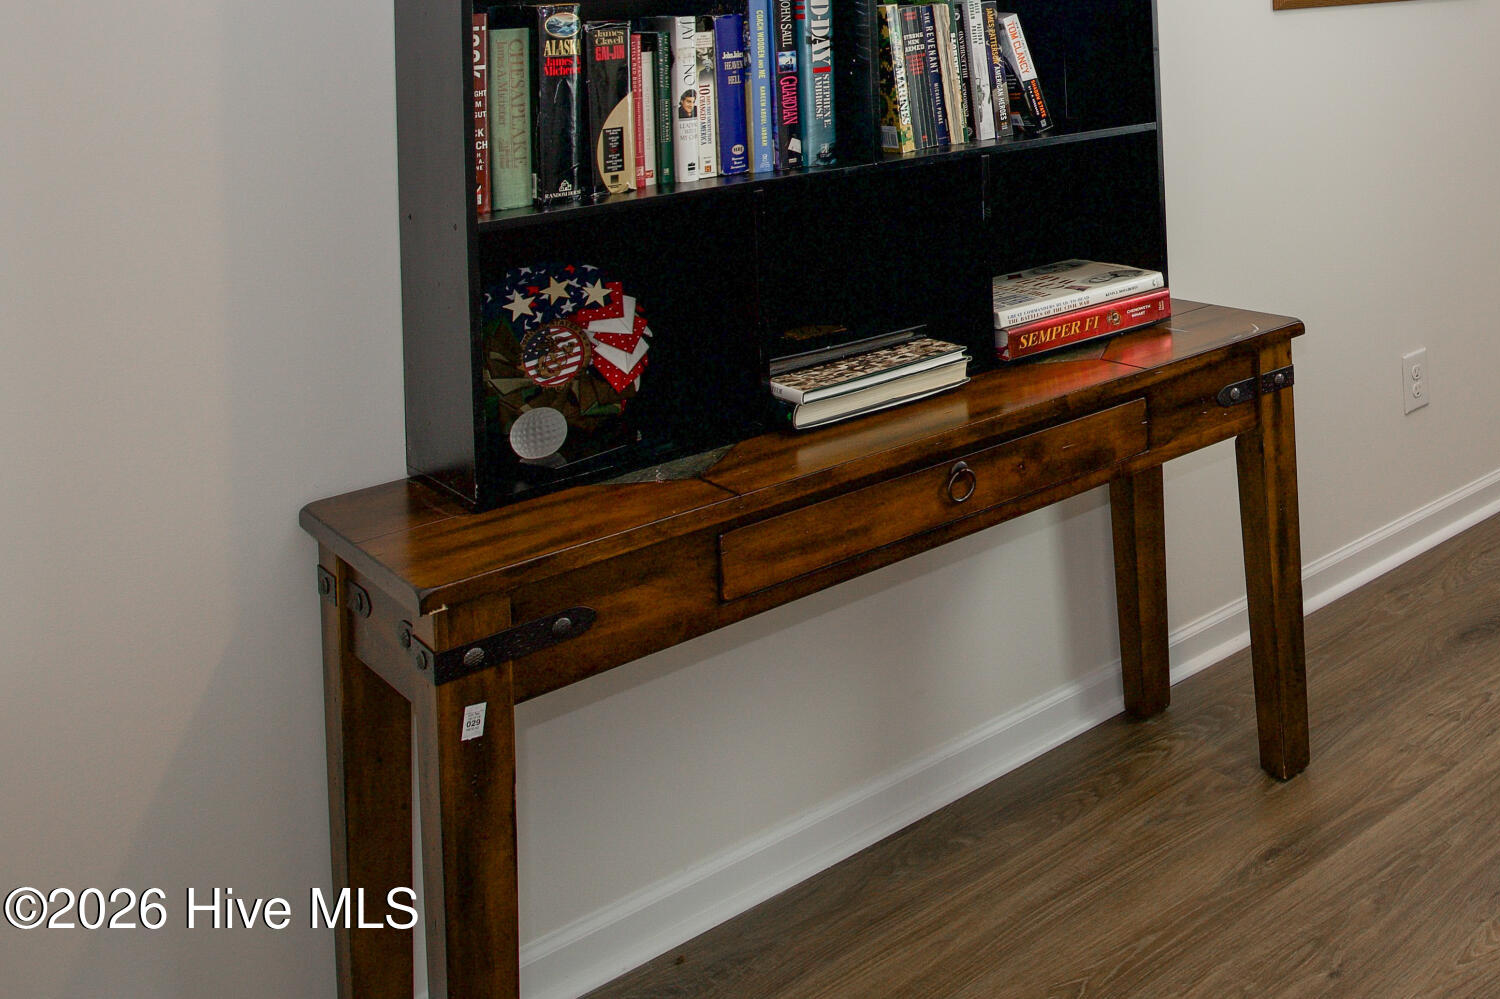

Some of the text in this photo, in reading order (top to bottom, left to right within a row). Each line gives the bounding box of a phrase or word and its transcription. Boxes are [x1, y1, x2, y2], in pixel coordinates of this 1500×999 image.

[680, 17, 695, 41] JAY
[755, 9, 764, 31] COACH
[594, 29, 624, 38] James
[595, 36, 624, 46] Clavell
[757, 31, 766, 58] WOODEN
[780, 23, 793, 48] SAUL
[544, 39, 581, 57] ALASKA
[594, 44, 625, 62] GAI-JIN
[905, 44, 925, 53] ARMED
[925, 25, 939, 74] REVENANT
[1007, 21, 1030, 75] TOM CLANCY
[544, 56, 573, 67] James
[985, 7, 1008, 121] JAMES PATTERSON AMERICAN HEROES
[727, 75, 741, 85] HELL
[758, 69, 766, 79] ME
[698, 83, 710, 95] 10
[814, 75, 824, 120] AMBROSE
[508, 38, 528, 167] CHESAPEAKE
[780, 75, 798, 126] GUARDIAN
[822, 73, 832, 128] STEPHEN E.
[1079, 300, 1090, 308] WAR
[1019, 315, 1100, 349] SEMPER FI
[466, 718, 481, 728] 029
